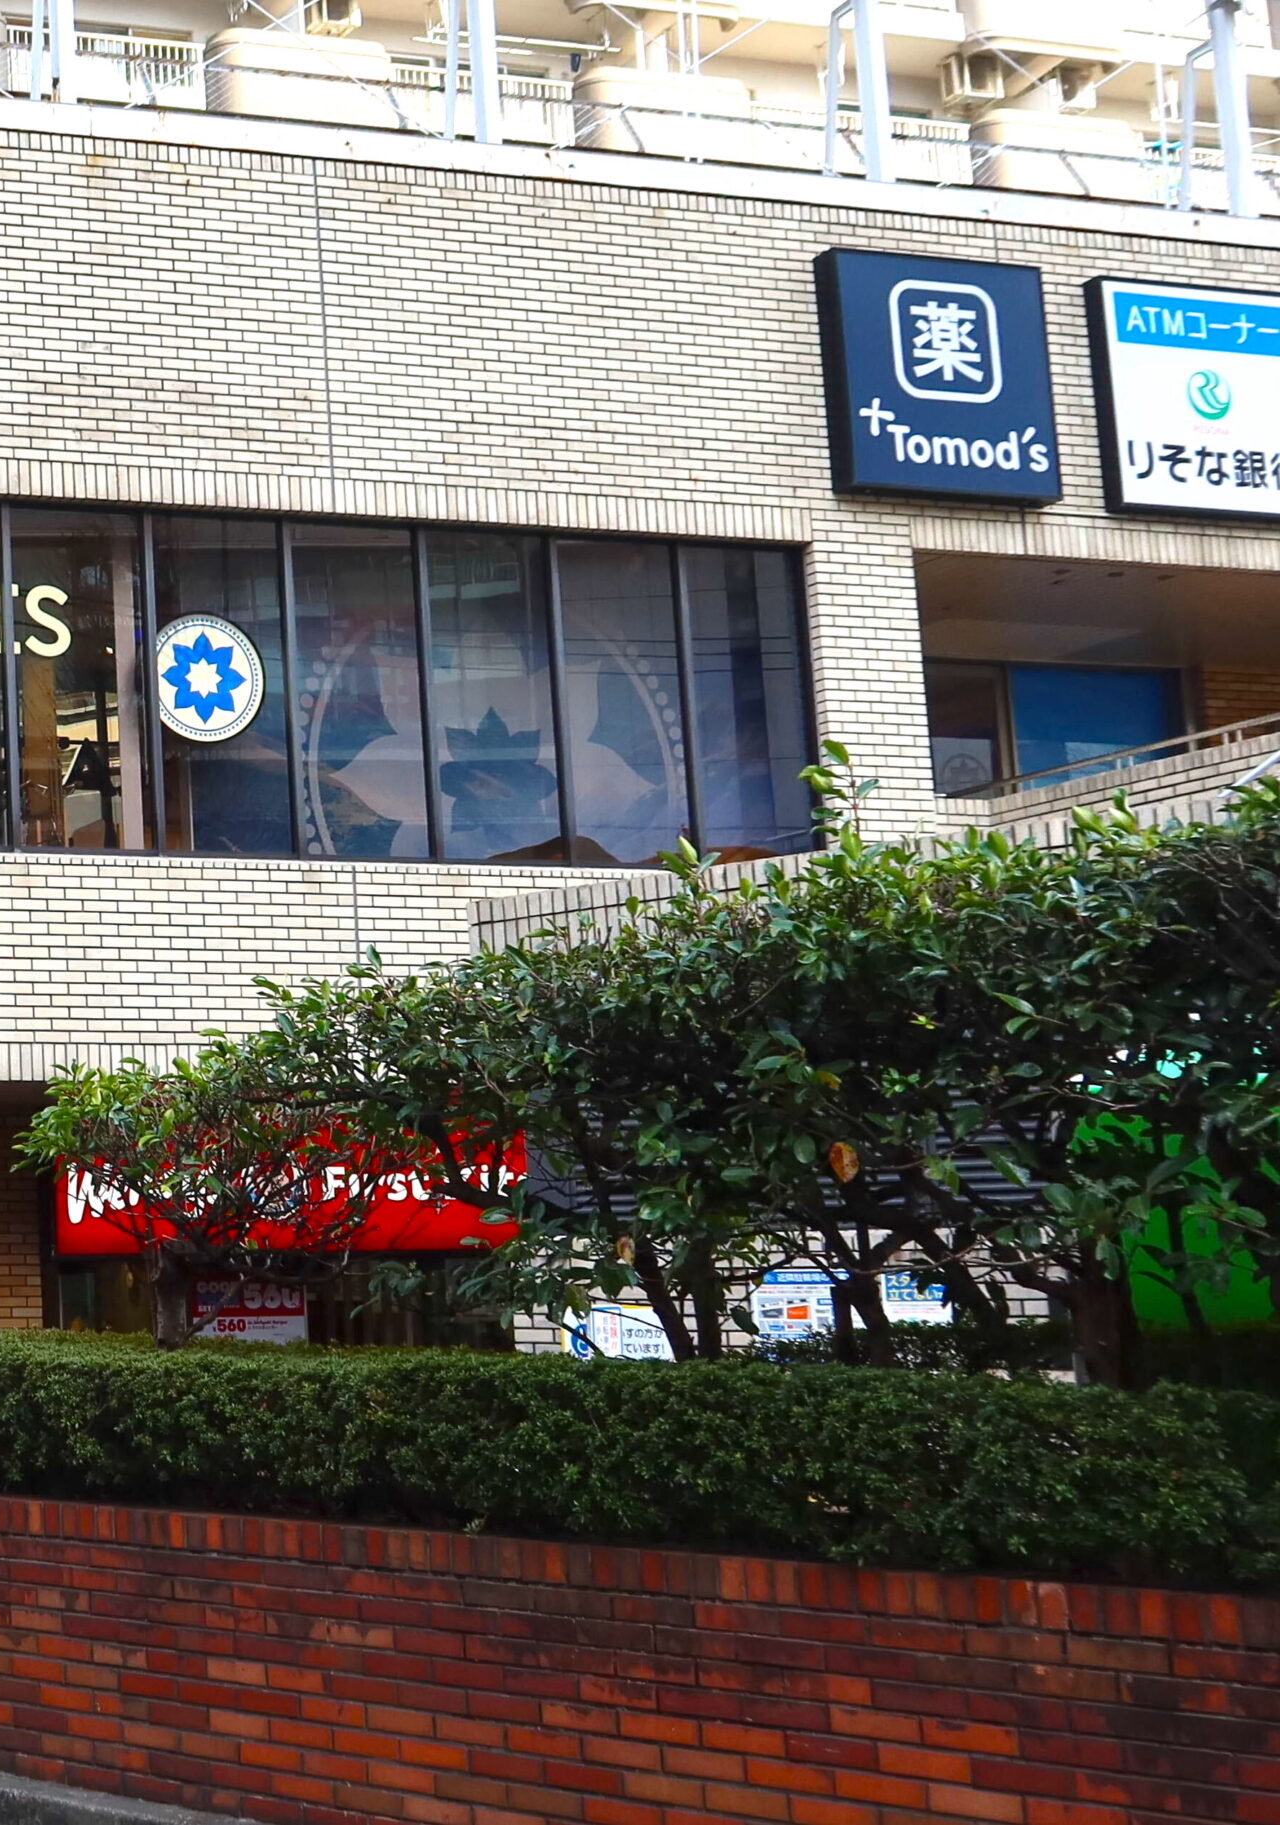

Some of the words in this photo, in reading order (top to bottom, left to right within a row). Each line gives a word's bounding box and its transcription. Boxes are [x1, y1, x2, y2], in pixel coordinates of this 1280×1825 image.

[909, 301, 984, 383] 薬
[1126, 304, 1279, 344] ATMコーナー
[886, 424, 1050, 473] Tomod's
